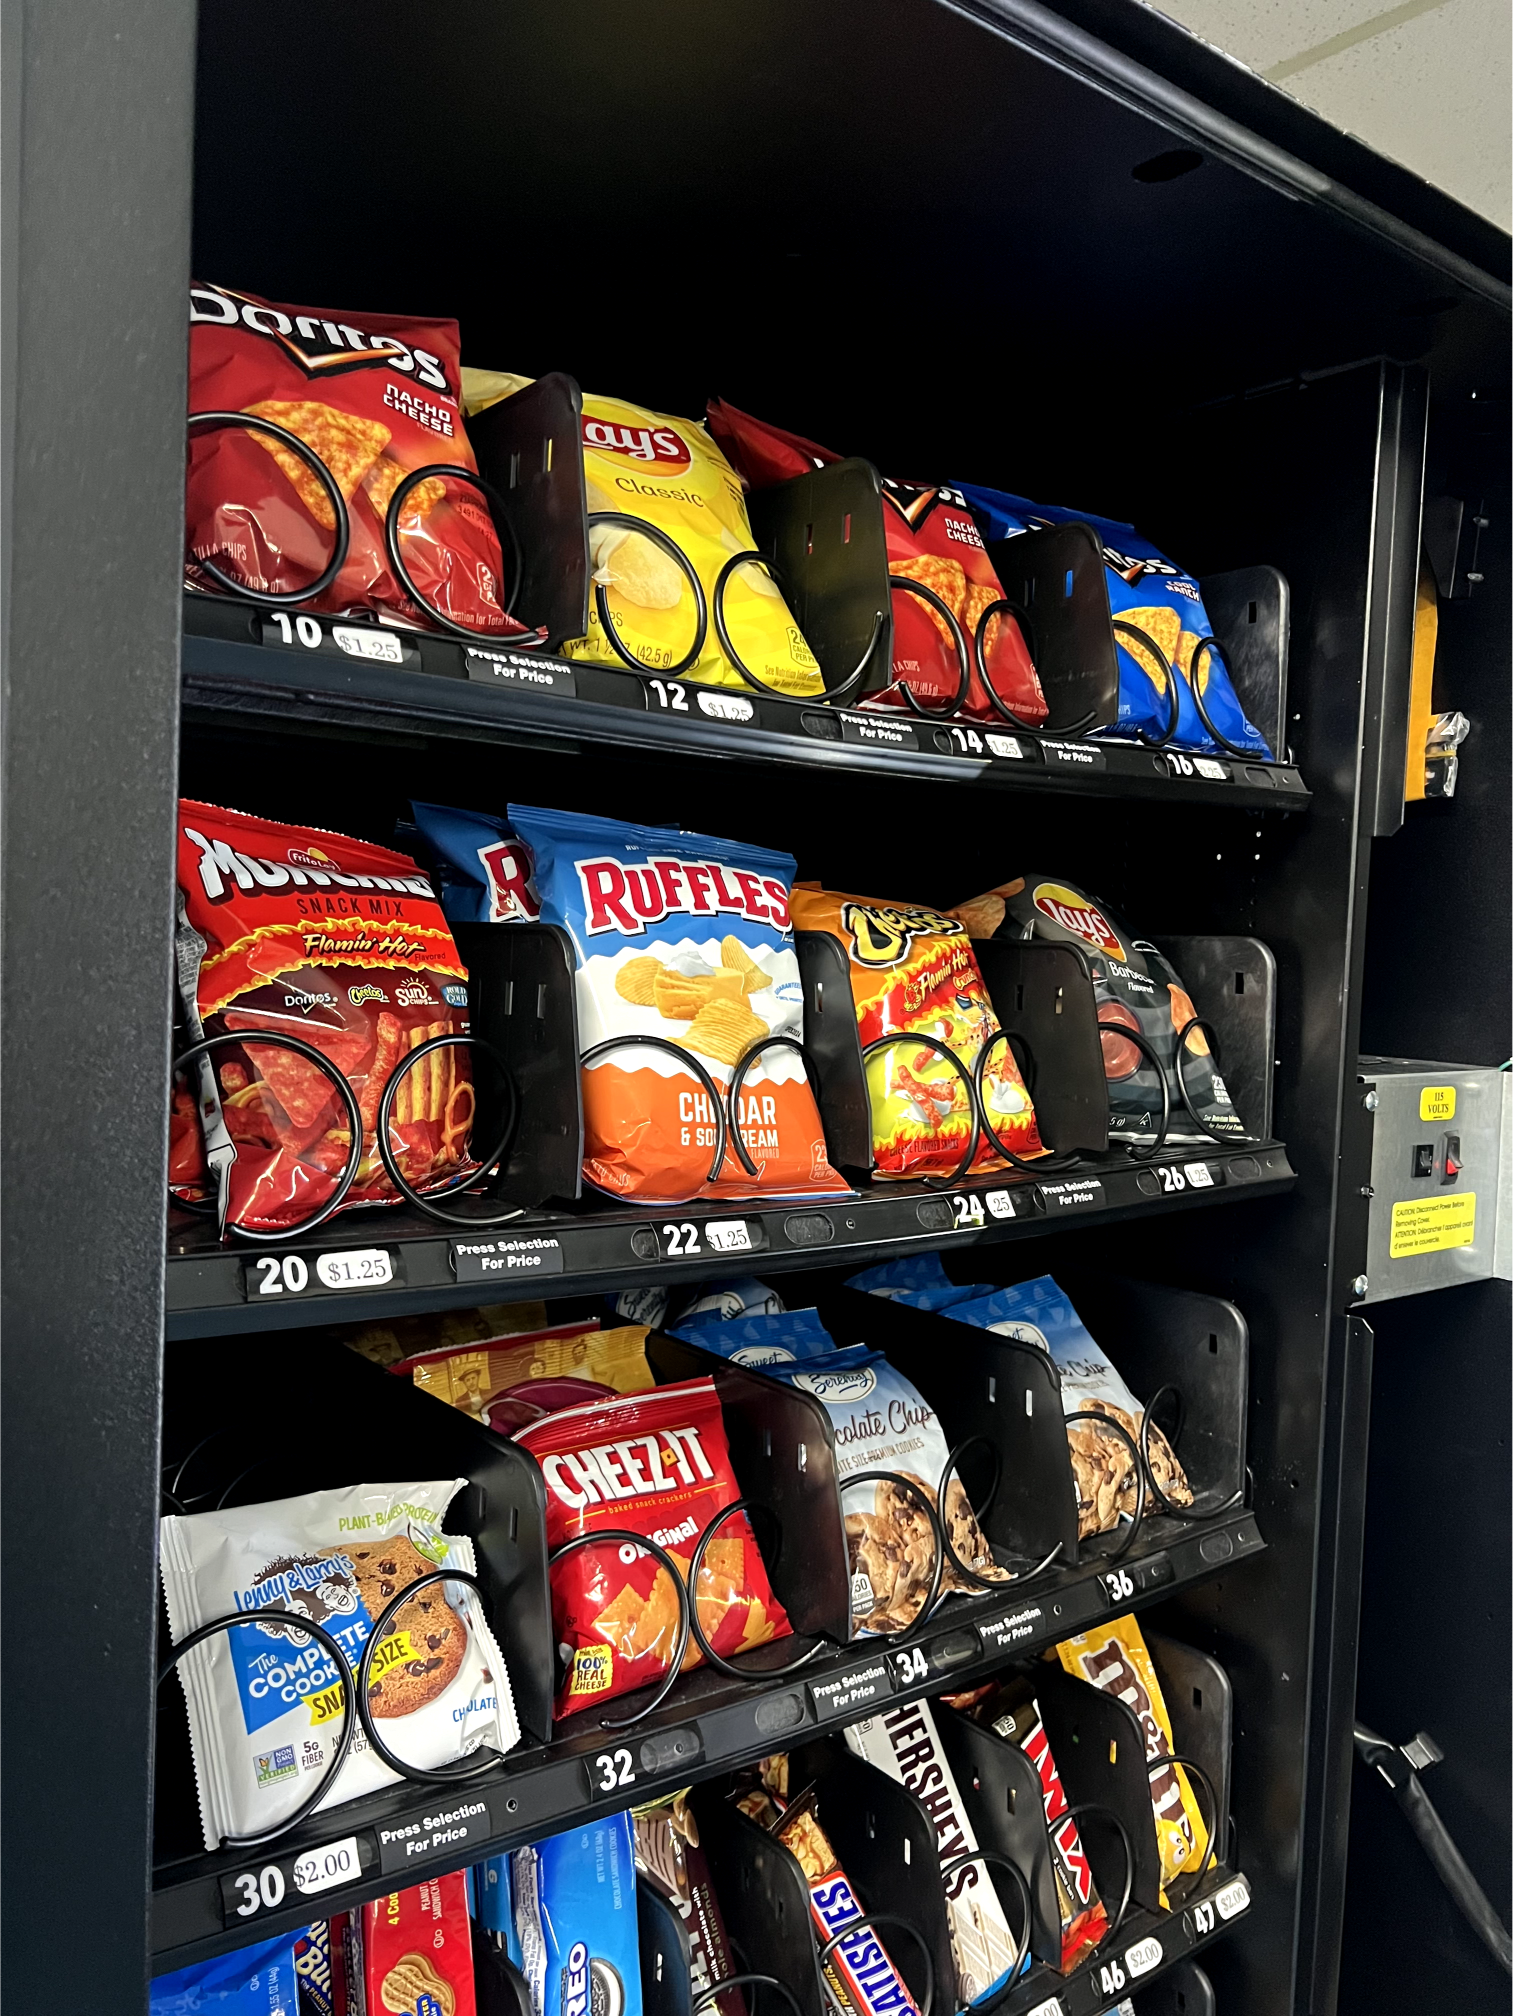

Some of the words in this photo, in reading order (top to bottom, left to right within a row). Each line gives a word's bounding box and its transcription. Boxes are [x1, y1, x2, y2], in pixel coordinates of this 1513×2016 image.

[383, 395, 453, 436] CHEESE
[386, 383, 450, 423] NACHO
[584, 422, 680, 461] ay's
[616, 477, 704, 508] Classic
[222, 541, 247, 561] CHIPS
[589, 610, 624, 627] CPS
[271, 612, 323, 649] 10
[338, 624, 399, 651] $1.25
[467, 646, 508, 663] Press
[508, 653, 572, 675] Selection
[636, 644, 662, 664] (42.5
[662, 650, 673, 669] g)
[493, 663, 517, 679] For
[518, 666, 554, 685] Price
[649, 679, 690, 712] 12
[707, 702, 749, 722] $1.25
[839, 712, 869, 726] Press
[868, 717, 913, 733] Selection
[859, 726, 877, 738] For
[878, 729, 903, 742] Price
[951, 727, 984, 754] 14
[1040, 739, 1065, 749] Press
[1063, 742, 1102, 753] Selection
[1057, 750, 1072, 761] For
[1072, 751, 1093, 763] Price
[1166, 753, 1194, 776] 16
[296, 897, 362, 916] SNACK
[369, 898, 405, 917] MIX
[580, 860, 793, 932] RUFFLES
[1042, 898, 1111, 948] Lay's
[302, 932, 375, 956] Flamin'
[378, 935, 426, 956] Hot
[414, 952, 447, 962] Flavored
[951, 948, 969, 971] Hot
[349, 985, 384, 1006] Cheetos
[395, 986, 430, 1004] Sun
[773, 982, 802, 996] GUARANTEE
[1127, 981, 1155, 994] Flavored
[408, 997, 430, 1006] CHIPS
[1427, 1103, 1450, 1115] VOLTS
[1434, 1091, 1444, 1102] 115
[680, 1126, 691, 1147] &
[738, 1128, 779, 1148] REAM
[1041, 1182, 1065, 1196] Press
[1065, 1178, 1102, 1193] Selection
[1157, 1167, 1186, 1193] 26
[953, 1194, 985, 1224] 24
[1058, 1193, 1073, 1206] For
[1073, 1191, 1094, 1204] Price
[456, 1242, 496, 1257] Press
[497, 1237, 560, 1254] Selection
[662, 1223, 702, 1256] 22
[256, 1255, 309, 1295] 20
[327, 1257, 388, 1285] $1.25
[481, 1257, 505, 1271] For
[506, 1254, 542, 1268] Price
[835, 1410, 887, 1447] colate
[888, 1396, 936, 1435] Chip
[851, 1452, 869, 1469] SIZE
[894, 1436, 926, 1455] COOKIES
[608, 1502, 634, 1515] baked
[634, 1497, 657, 1511] snack
[658, 1490, 693, 1506] crackers
[233, 1570, 292, 1612] Lenny
[286, 1571, 300, 1589] &
[294, 1554, 355, 1591] Larry's
[1106, 1569, 1134, 1601] 36
[979, 1621, 1005, 1638] Press
[1004, 1606, 1042, 1629] Selection
[997, 1632, 1012, 1646] For
[1011, 1623, 1034, 1642] Price
[248, 1652, 279, 1675] The
[372, 1638, 409, 1674] SIZE
[576, 1655, 609, 1671] 100%
[896, 1647, 930, 1685] 34
[281, 1655, 358, 1702] COOKE
[574, 1679, 608, 1691] CHEESE
[577, 1668, 608, 1682] REAL
[813, 1682, 842, 1699] Press
[841, 1663, 886, 1687] Selection
[832, 1693, 851, 1708] For
[850, 1684, 876, 1703] Price
[275, 1744, 292, 1757] NON
[276, 1752, 294, 1765] GMO
[301, 1751, 325, 1768] FIBER
[302, 1740, 320, 1754] 5G
[258, 1764, 298, 1782] VERIFIED
[595, 1748, 636, 1792] 32
[380, 1823, 421, 1846] Press
[422, 1801, 487, 1832] Selection
[405, 1838, 429, 1856] For
[430, 1826, 468, 1851] Price
[608, 1827, 618, 1850] COOKIES
[609, 1850, 619, 1879] SANDWICH
[234, 1865, 286, 1918] 30
[292, 1849, 352, 1888] $2.00
[611, 1879, 623, 1910] CHOCOLATE
[1065, 1884, 1075, 1900] bars
[418, 1884, 431, 1911] PEANUT
[430, 1884, 442, 1920] SANDWICH
[691, 1885, 702, 1909] with
[1194, 1900, 1215, 1934] 47
[1219, 1885, 1247, 1913] $2.00
[387, 1916, 400, 1925] 4
[700, 1882, 721, 1945] almonds
[698, 1909, 715, 1957] chocolate
[566, 1942, 588, 2016] REO
[710, 1957, 721, 1981] milk
[1099, 1960, 1126, 1996] 46
[1129, 1942, 1160, 1969] $2.00
[308, 1986, 331, 2012] PEANUT
[533, 1979, 541, 2007] Calories
[823, 1967, 851, 2008] PEANUTS
